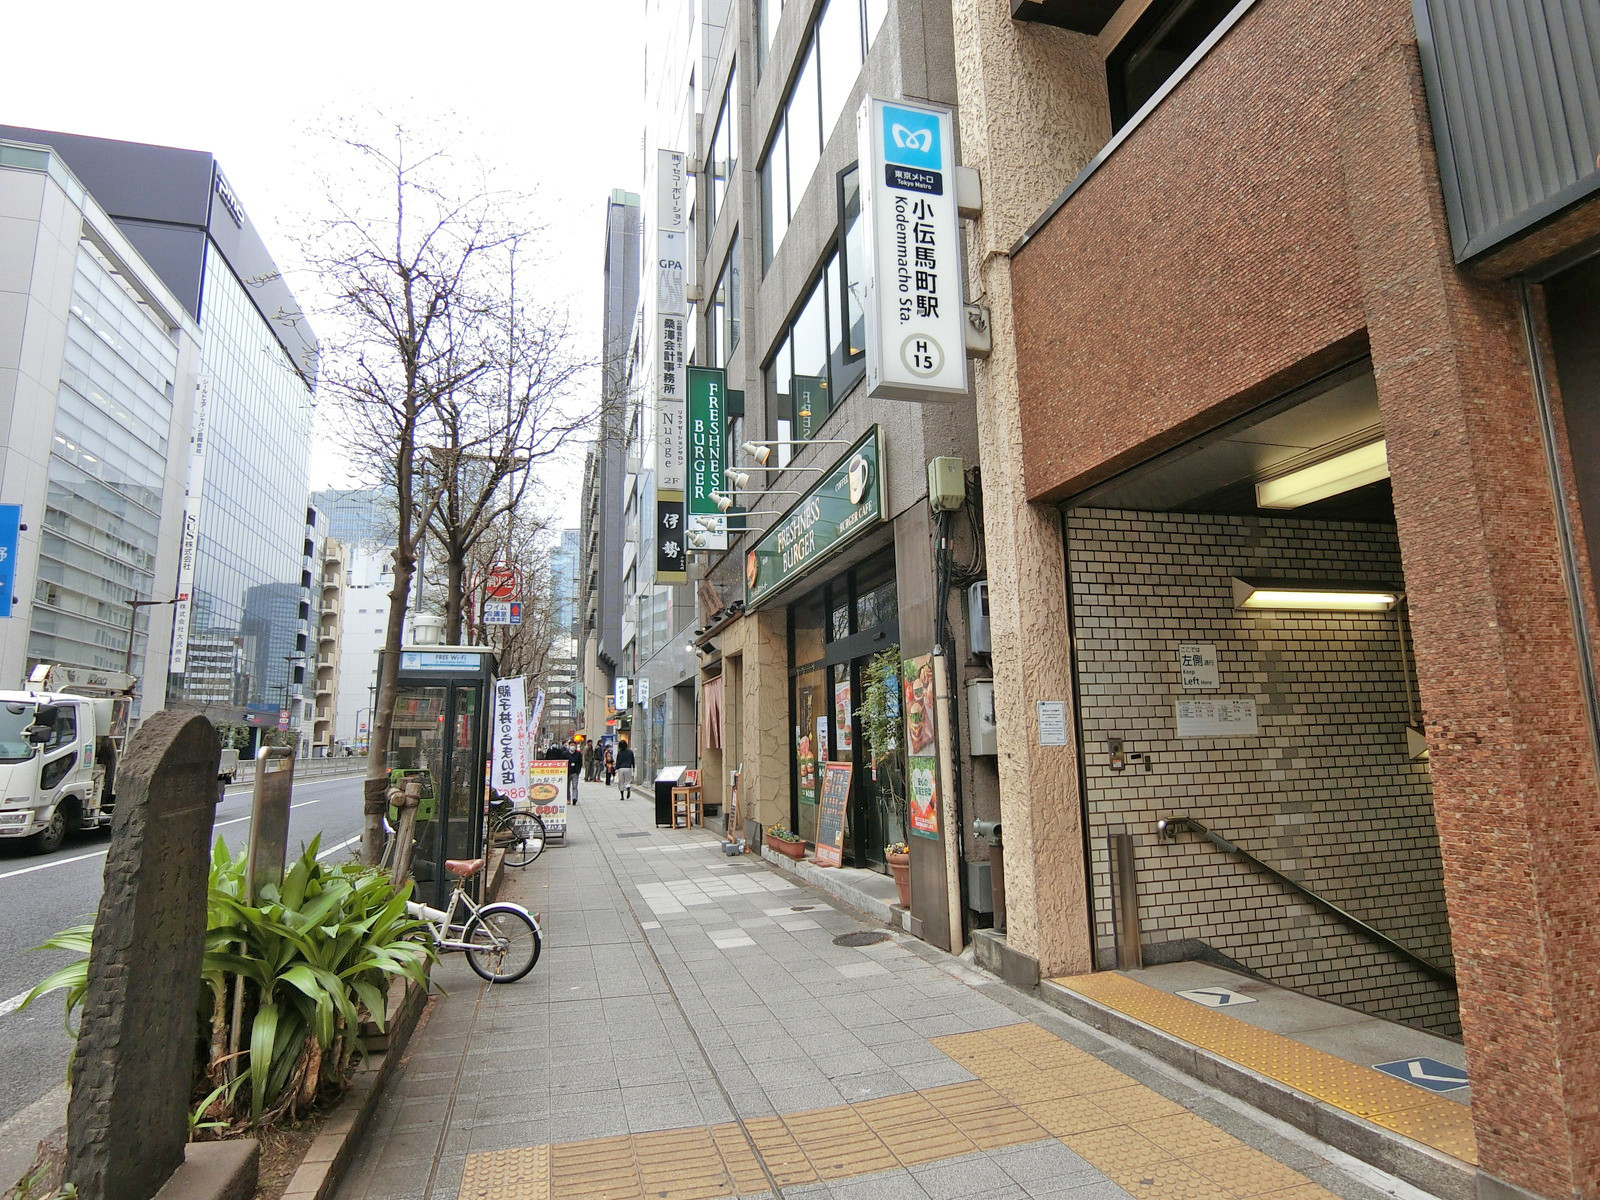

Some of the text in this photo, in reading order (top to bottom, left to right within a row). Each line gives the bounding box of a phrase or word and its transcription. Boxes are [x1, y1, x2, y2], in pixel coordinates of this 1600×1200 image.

[894, 170, 934, 184] 東京メトロ
[897, 178, 932, 190] Tokyo Metro
[659, 258, 683, 270] GPA
[894, 196, 912, 325] Kodemmacho Sta.
[912, 198, 939, 319] 小伝馬町駅
[916, 340, 928, 354] H
[914, 354, 933, 370] 15
[662, 412, 674, 468] Nuage
[694, 420, 706, 500] BURGER
[664, 477, 681, 485] 2F
[777, 497, 820, 554] FRESHNESS
[839, 512, 858, 534] BURGER
[662, 512, 681, 559] 伊勢
[782, 529, 816, 573] BURGER
[1184, 676, 1200, 686] Left
